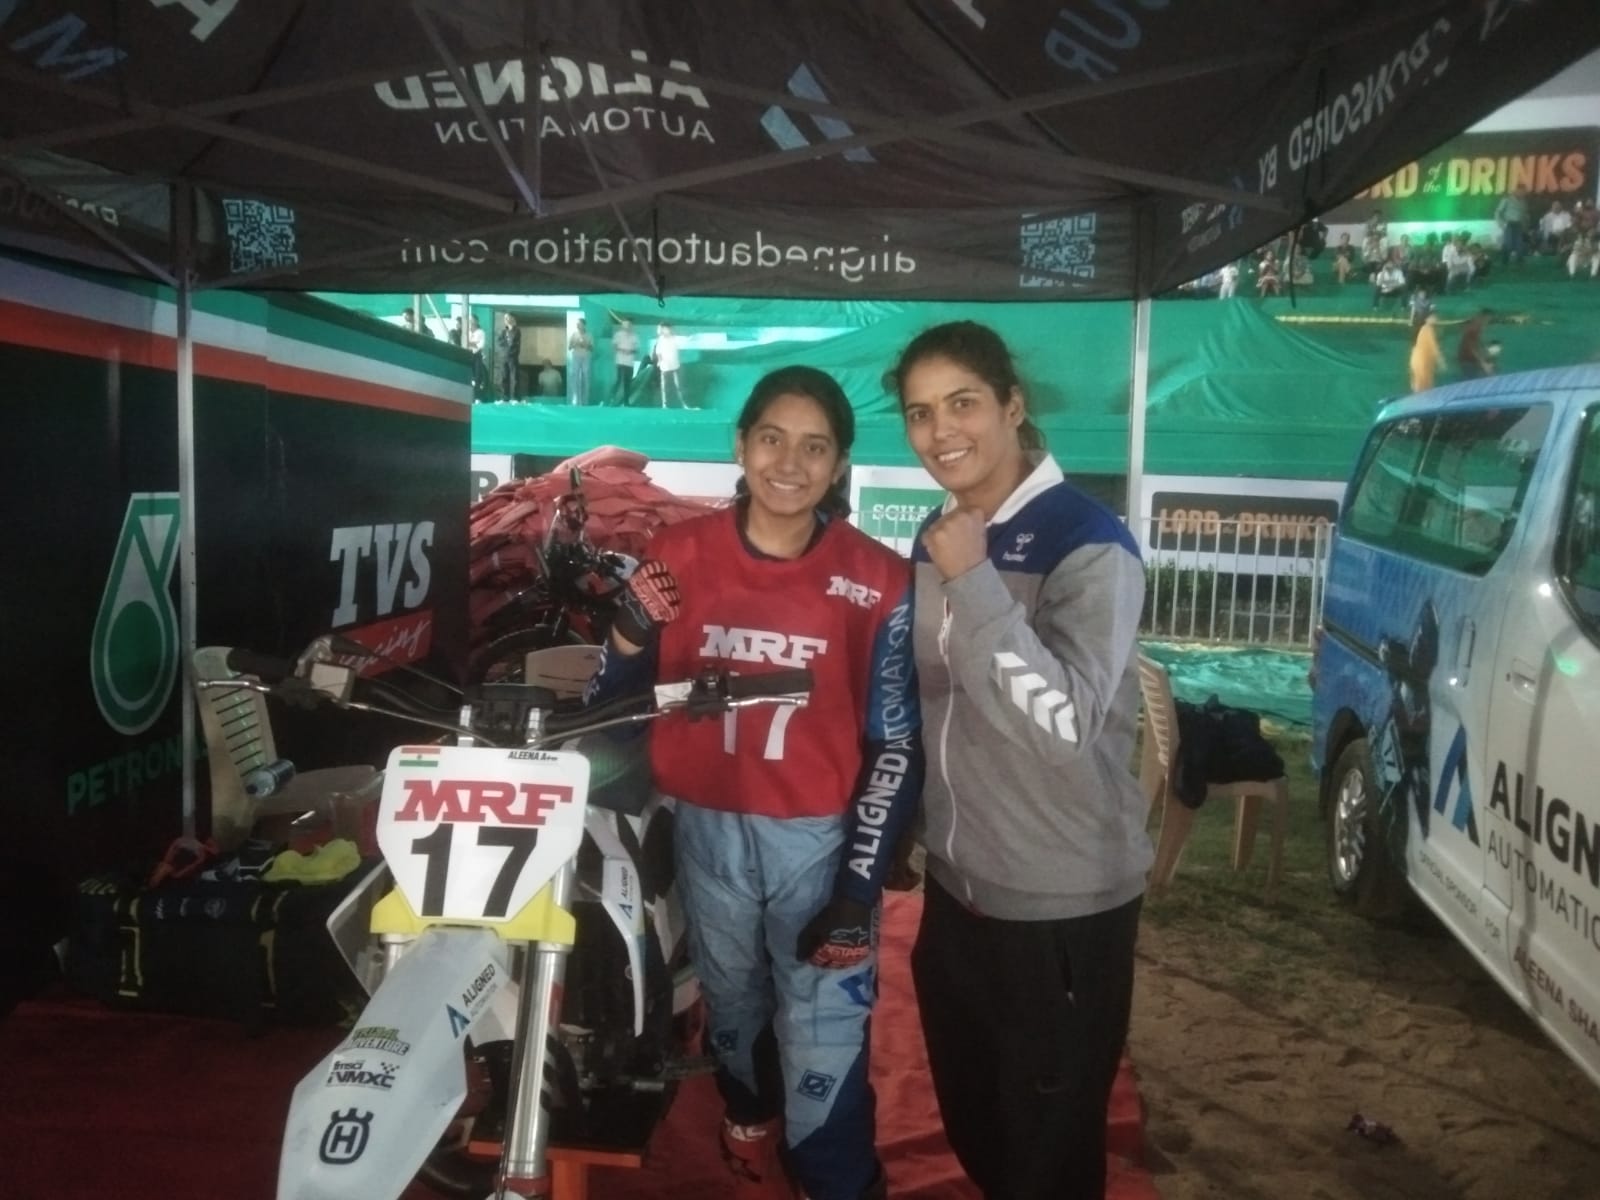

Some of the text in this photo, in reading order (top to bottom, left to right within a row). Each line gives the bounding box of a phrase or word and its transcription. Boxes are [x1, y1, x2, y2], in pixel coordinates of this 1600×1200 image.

[1446, 151, 1586, 197] DRINKS
[330, 521, 435, 628] TVS
[826, 575, 882, 609] MRF
[699, 624, 828, 669] MRF
[67, 735, 208, 815] PETRON
[508, 750, 539, 760] ALEENA
[394, 780, 573, 825] MRF
[848, 752, 909, 880] ALIGNED
[411, 823, 538, 918] 17
[461, 963, 496, 1007] ALIGNED
[1513, 946, 1564, 1010] ALEENA
